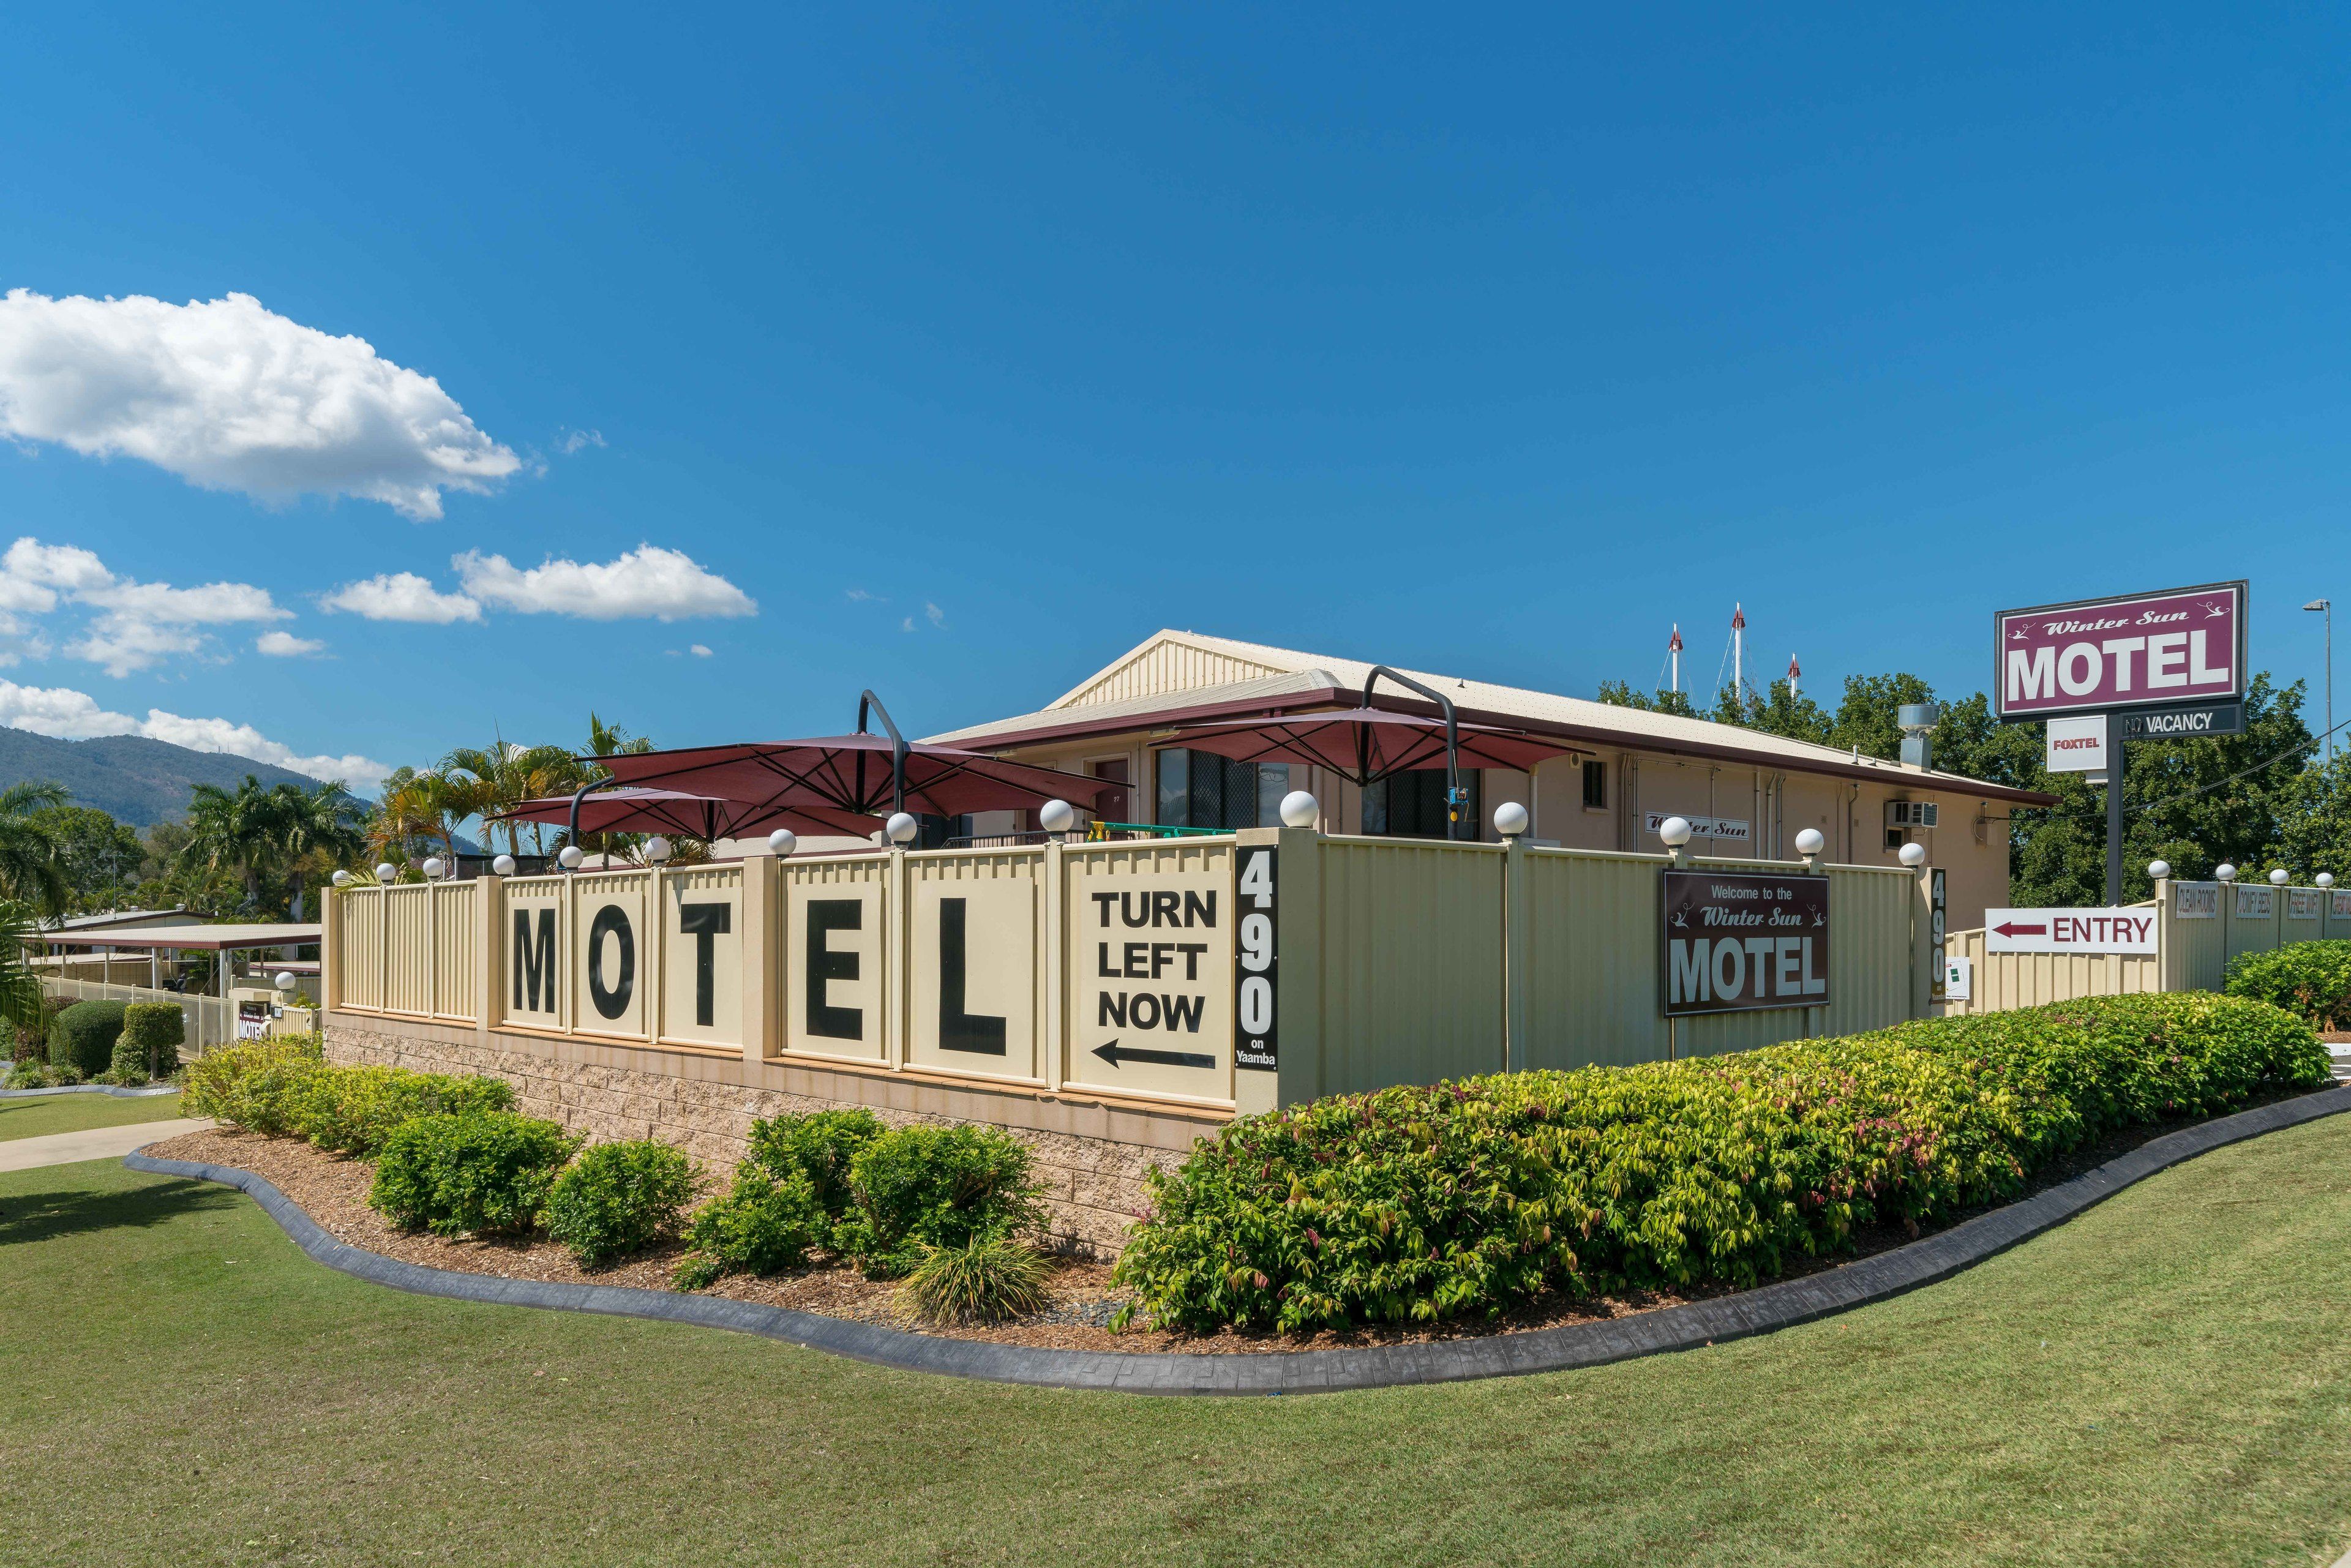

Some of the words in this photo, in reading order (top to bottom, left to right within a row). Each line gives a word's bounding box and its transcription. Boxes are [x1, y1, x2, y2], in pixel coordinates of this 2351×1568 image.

[2042, 617, 2129, 636] Winter
[2135, 610, 2190, 625] Sun
[2008, 629, 2229, 702] MOTEL
[2146, 712, 2213, 733] VACANCY
[2053, 738, 2100, 750] FOXTEL
[1647, 816, 1710, 833] Wter
[1714, 822, 1747, 837] Sun
[1711, 884, 1758, 899] Welcome
[1763, 887, 1772, 899] to
[1777, 887, 1793, 900] the
[2178, 888, 2196, 913] CLEAN
[2197, 888, 2216, 913] ROOMS
[1091, 890, 1217, 928] TURN
[1700, 906, 1764, 926] Winter
[1768, 907, 1803, 926] Sun
[1932, 872, 1945, 983] 490
[2053, 917, 2153, 943] ENTRY
[1240, 850, 1273, 1035] 490
[1098, 942, 1208, 981] LEFT
[1670, 936, 1826, 1004] MOTEL
[512, 897, 1007, 1057] MOTEL
[1098, 991, 1206, 1033] NOW
[1236, 1049, 1275, 1065] Yaamba
[1251, 1039, 1264, 1049] on
